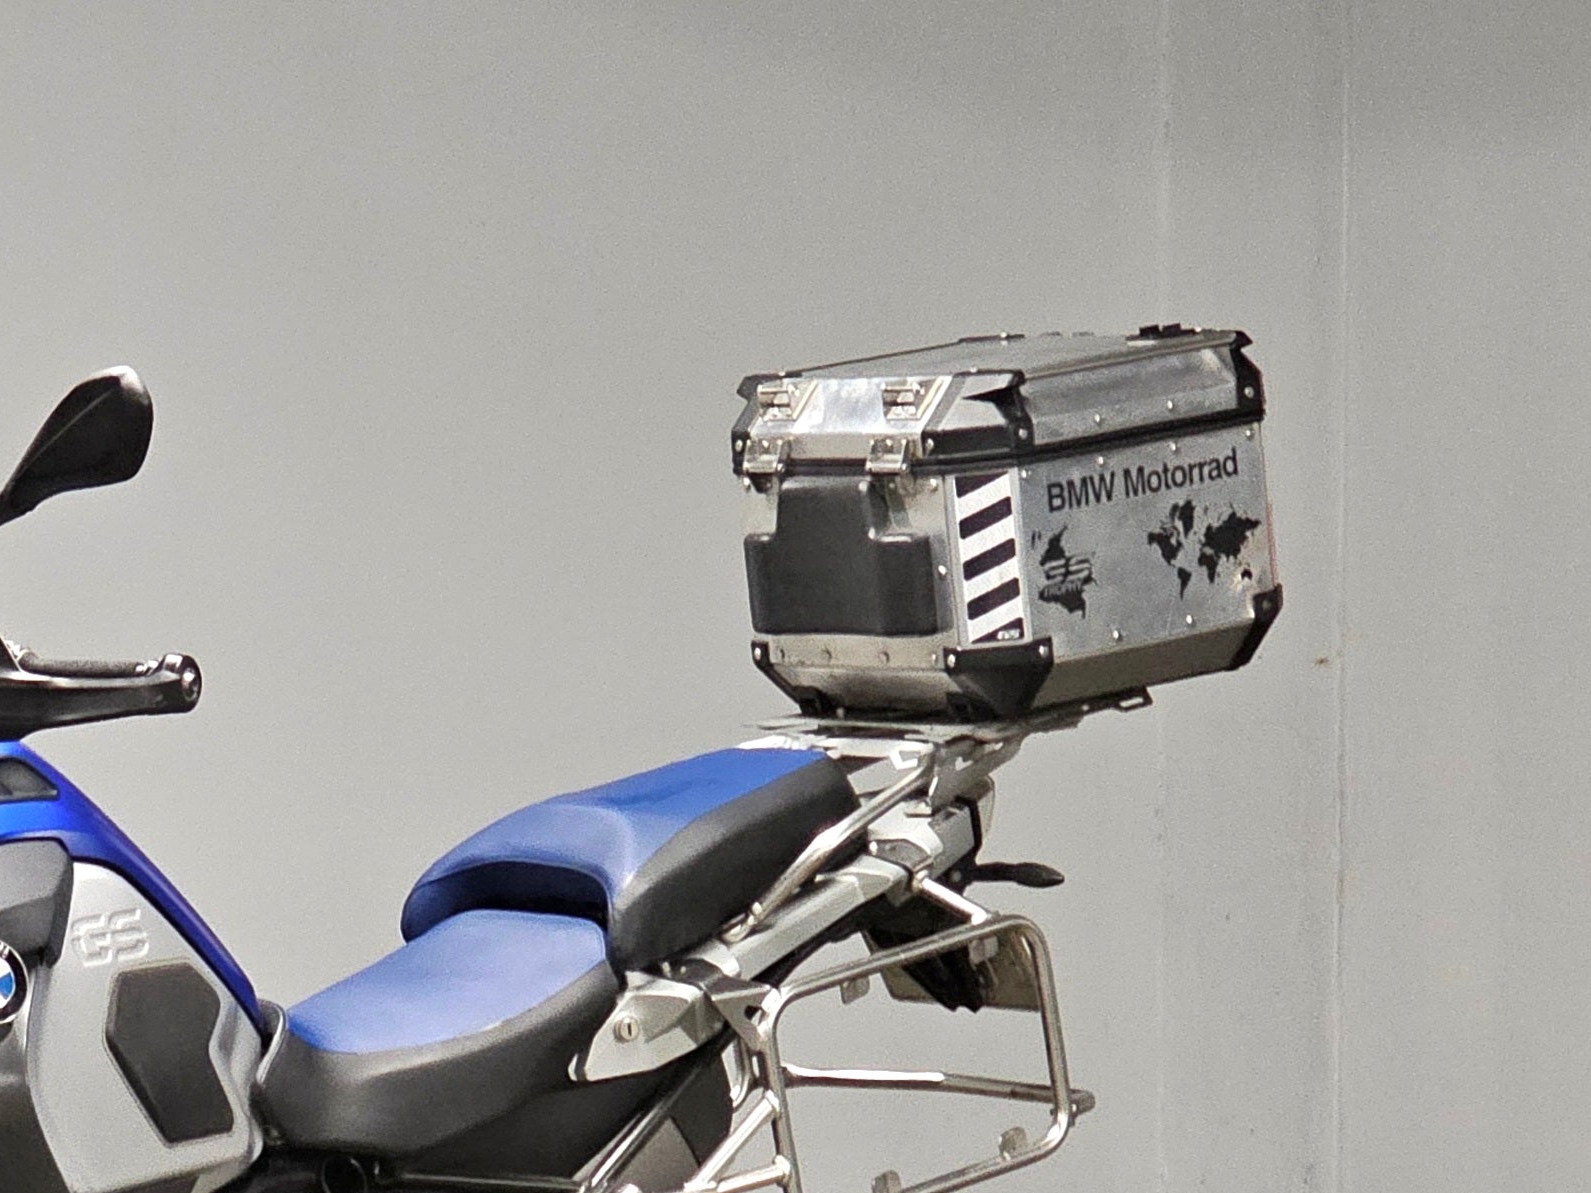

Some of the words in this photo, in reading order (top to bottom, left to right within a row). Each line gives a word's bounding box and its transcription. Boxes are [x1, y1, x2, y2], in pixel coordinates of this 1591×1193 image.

[1046, 470, 1116, 513] BMW
[1122, 446, 1239, 499] Motorrad
[71, 907, 150, 968] GS
